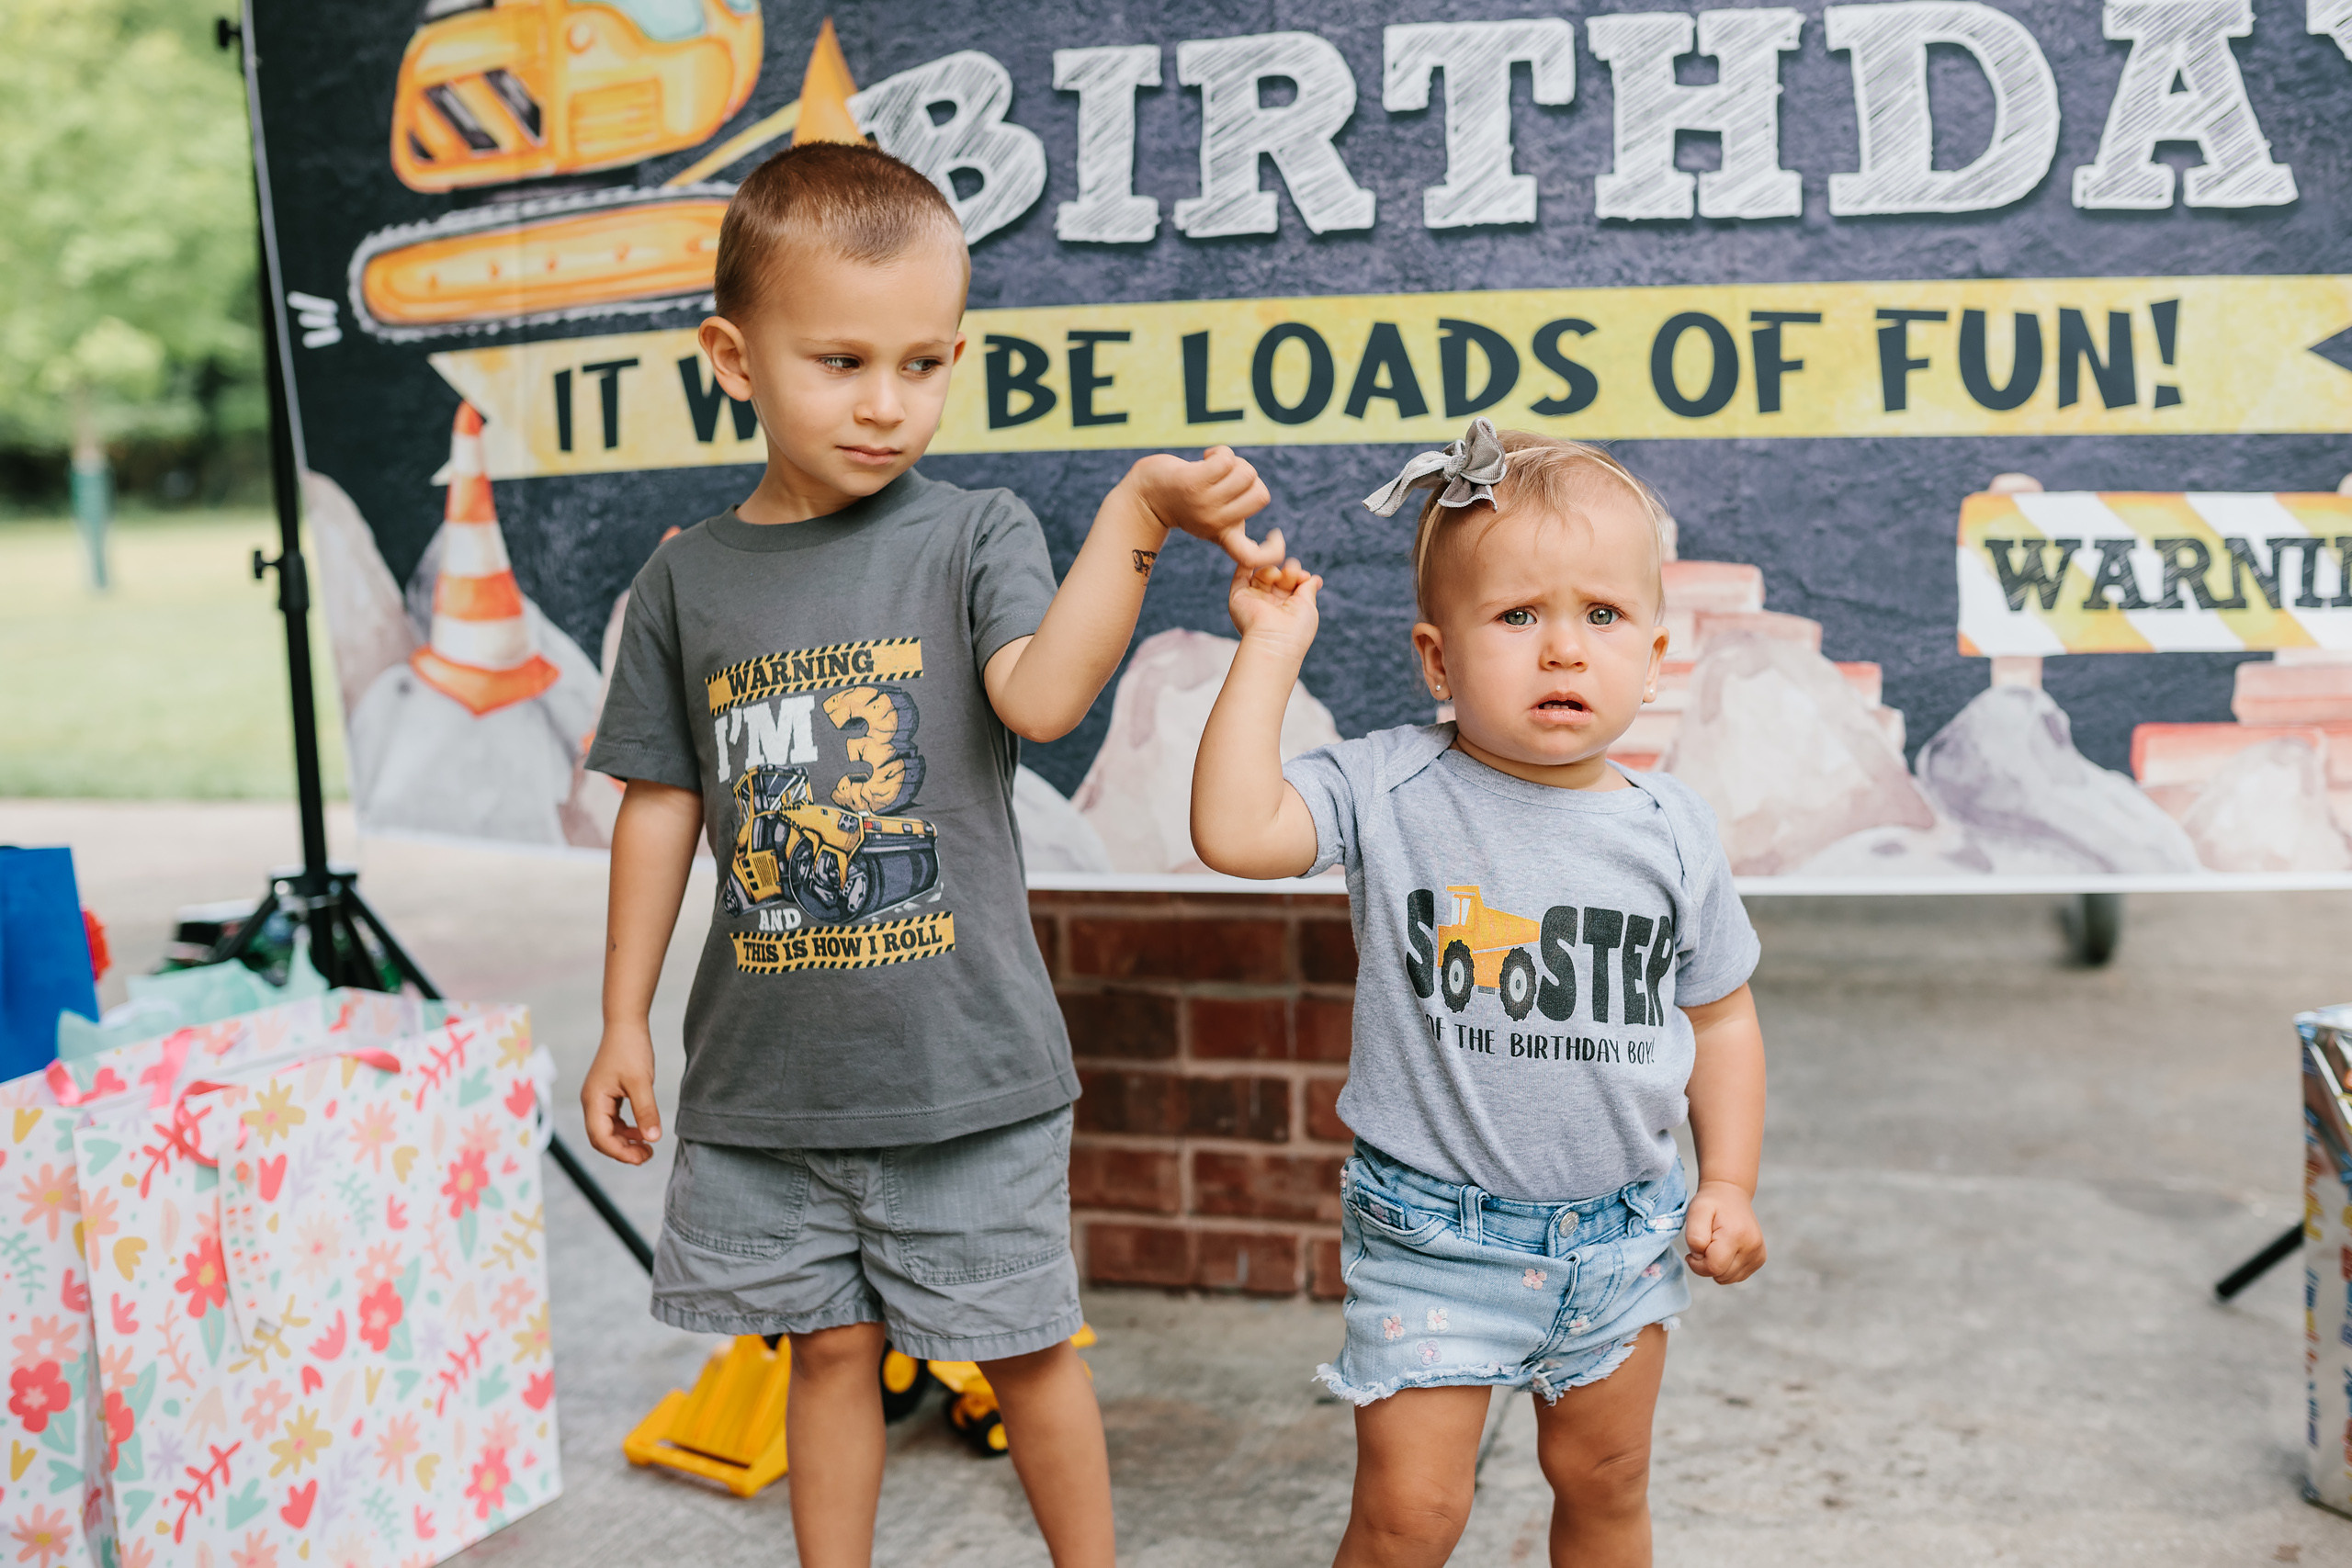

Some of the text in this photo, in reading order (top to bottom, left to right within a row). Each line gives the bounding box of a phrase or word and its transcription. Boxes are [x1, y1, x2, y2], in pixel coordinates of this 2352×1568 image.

[985, 299, 2184, 430] BE LOADS OF FUN!
[555, 357, 640, 452] IT
[1984, 536, 2352, 611] WARNI
[728, 649, 874, 698] WARNING
[714, 685, 927, 816] I'M 3
[742, 925, 943, 964] THIS IS HOW I ROLL
[758, 908, 802, 932] AND
[1453, 1023, 1496, 1055] THE
[1510, 1032, 1620, 1063] BIRTHDAY
